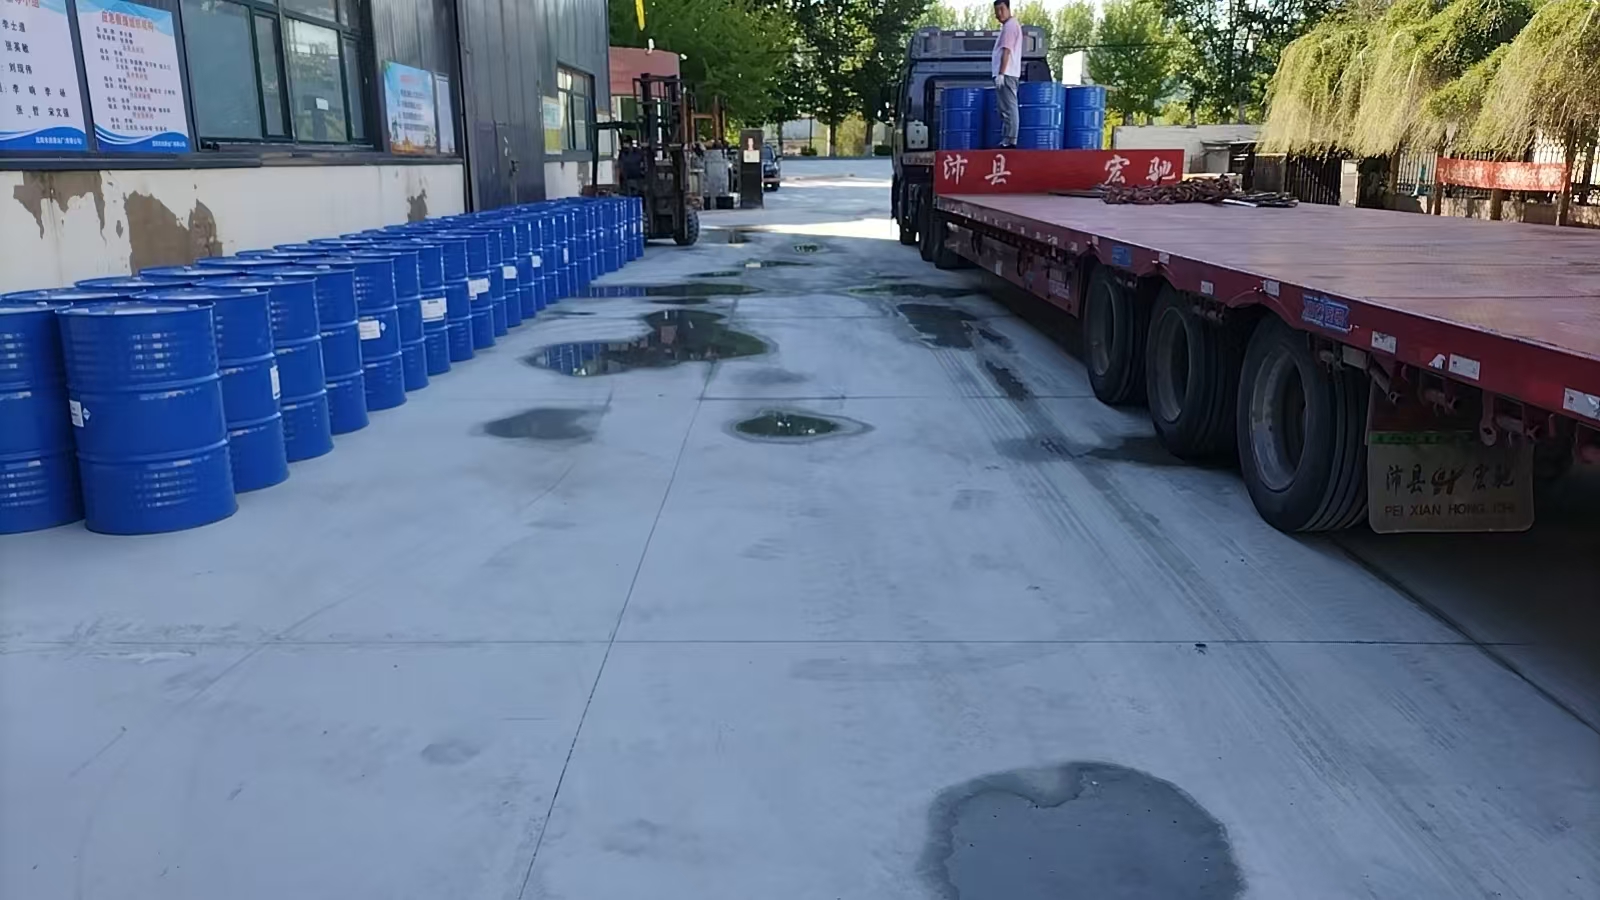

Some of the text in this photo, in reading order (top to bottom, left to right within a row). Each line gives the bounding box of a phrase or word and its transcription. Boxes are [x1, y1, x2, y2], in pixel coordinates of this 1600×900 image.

[943, 154, 1176, 185] 沛县 宏驰
[1384, 504, 1404, 517] PEI
[1409, 503, 1441, 517] XIAN
[1448, 502, 1485, 516] HONG
